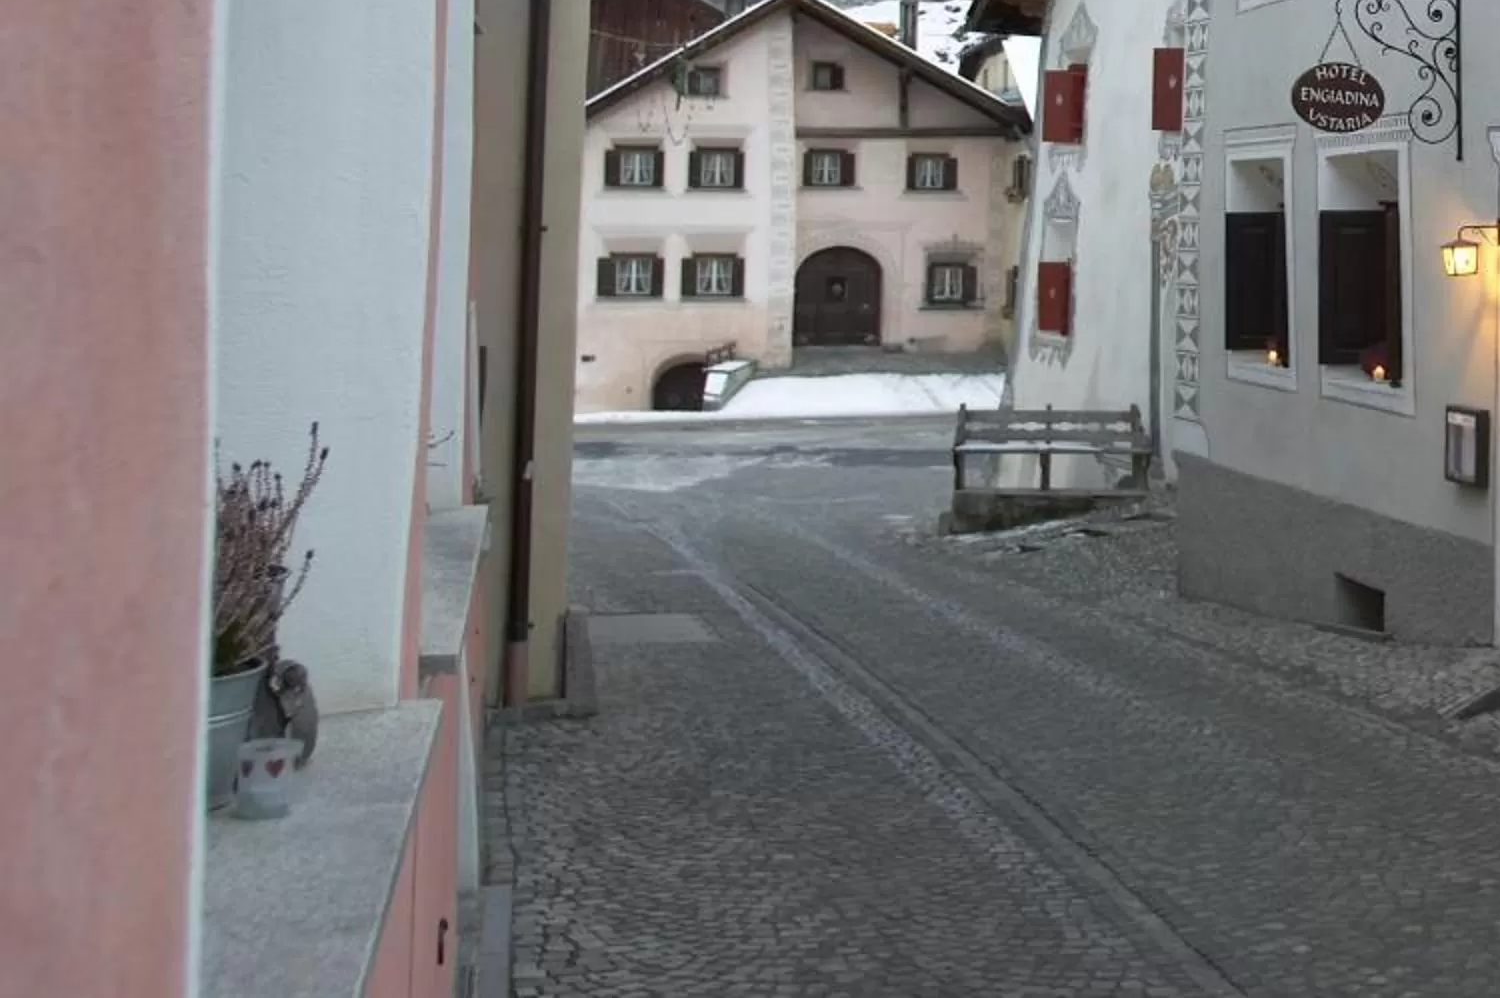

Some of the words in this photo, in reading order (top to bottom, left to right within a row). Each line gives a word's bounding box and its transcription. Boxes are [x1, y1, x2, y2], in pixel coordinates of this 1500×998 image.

[1315, 65, 1367, 85] HOTEL
[1301, 87, 1379, 107] ENGIADINA
[1309, 108, 1372, 131] USTARIA
